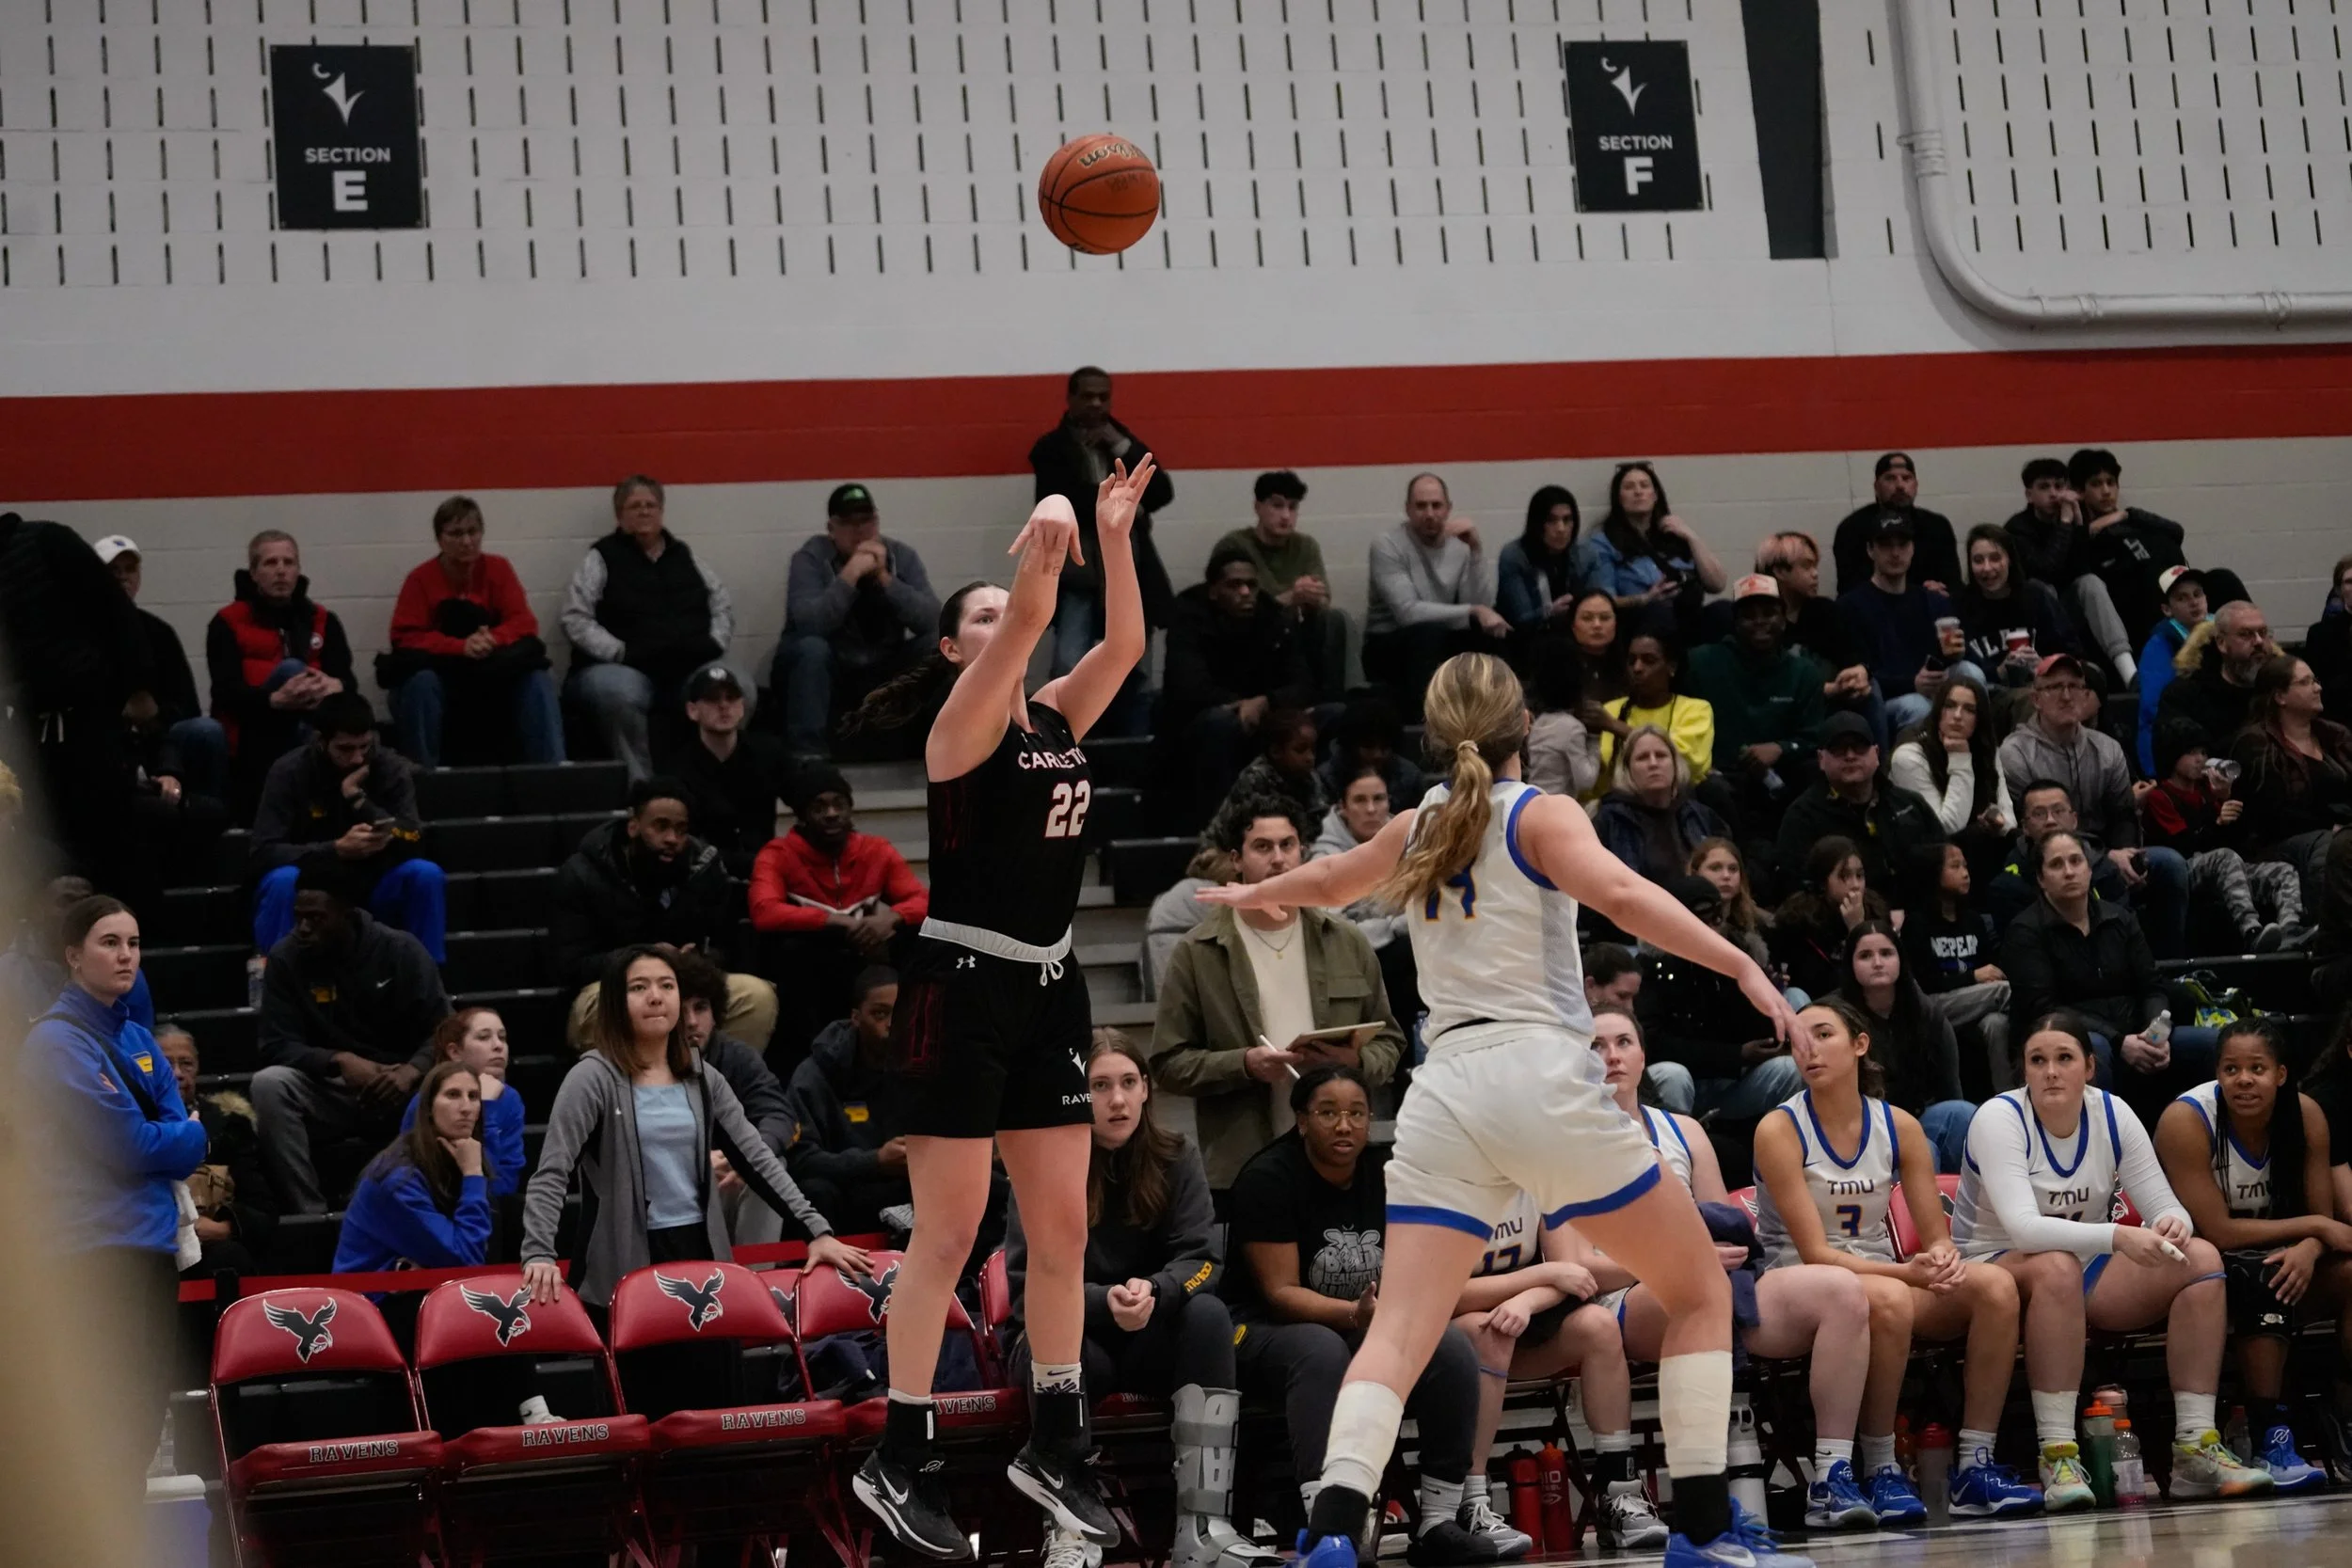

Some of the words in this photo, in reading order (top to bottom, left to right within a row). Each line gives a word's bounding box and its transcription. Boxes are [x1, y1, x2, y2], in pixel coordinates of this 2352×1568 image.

[1598, 135, 1674, 150] SECTION
[304, 147, 391, 163] SECTION
[1624, 156, 1654, 196] F
[333, 170, 368, 212] E
[1018, 747, 1087, 769] CARLETO
[1045, 779, 1091, 838] 22
[1061, 1092, 1093, 1105] RAVE
[1827, 1179, 1875, 1196] TMU
[2048, 1186, 2090, 1206] TMU
[2236, 1180, 2265, 1199] TM
[1494, 1216, 1523, 1240] MU
[930, 1395, 997, 1416] AVENS
[721, 1408, 806, 1431] RAVENS
[522, 1423, 610, 1448] RAVENS
[309, 1439, 399, 1463] RAVENS
